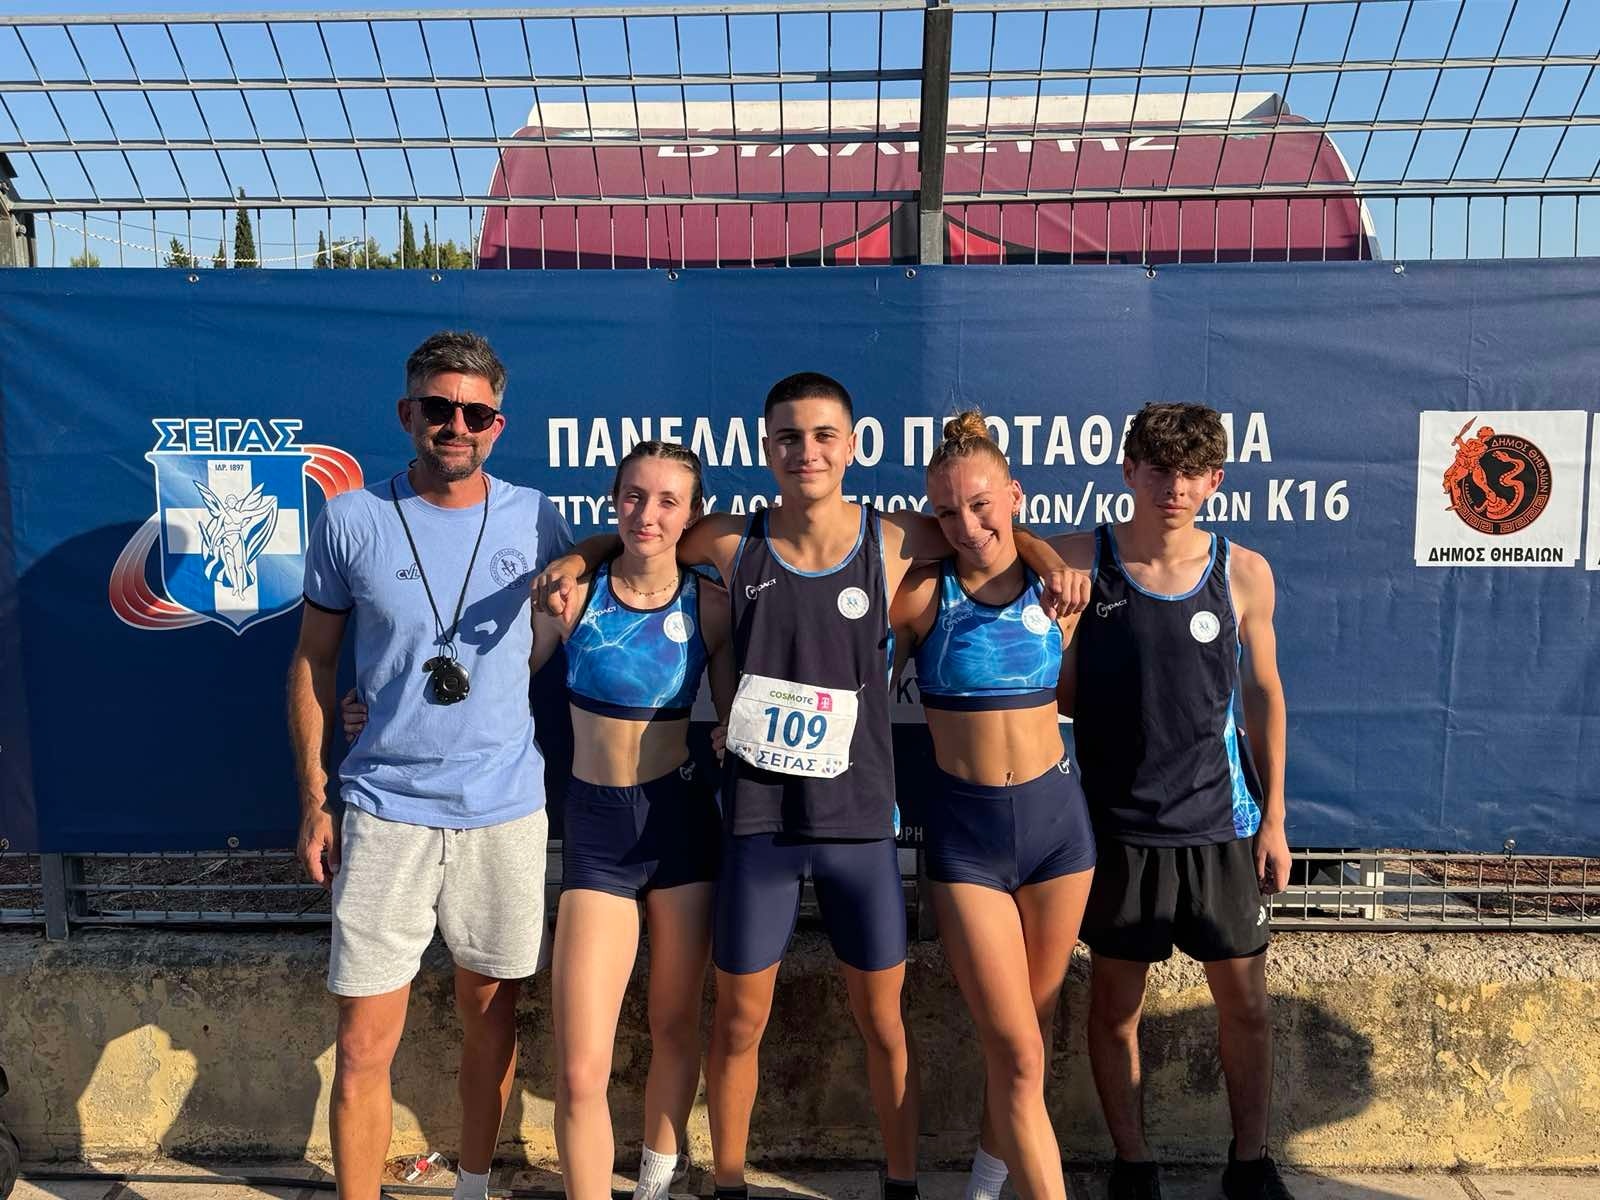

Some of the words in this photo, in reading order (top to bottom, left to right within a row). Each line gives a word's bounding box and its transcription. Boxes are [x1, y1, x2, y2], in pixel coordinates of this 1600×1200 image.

[151, 418, 303, 452] ΣΕΓΑΣ
[548, 415, 885, 467] ΠΑΝΕΛΛΟ
[1491, 438, 1529, 452] ΔΗΜΟΣ
[230, 464, 244, 472] 1897
[1267, 479, 1350, 521] Κ16
[1428, 547, 1485, 562] ΔΗΜΟΣ
[1490, 547, 1564, 562] ΘΗΒΑΙΩΝ
[769, 690, 814, 705] COSMOTE
[764, 706, 828, 750] 109
[757, 750, 818, 772] ΣΕΓΑΣ
